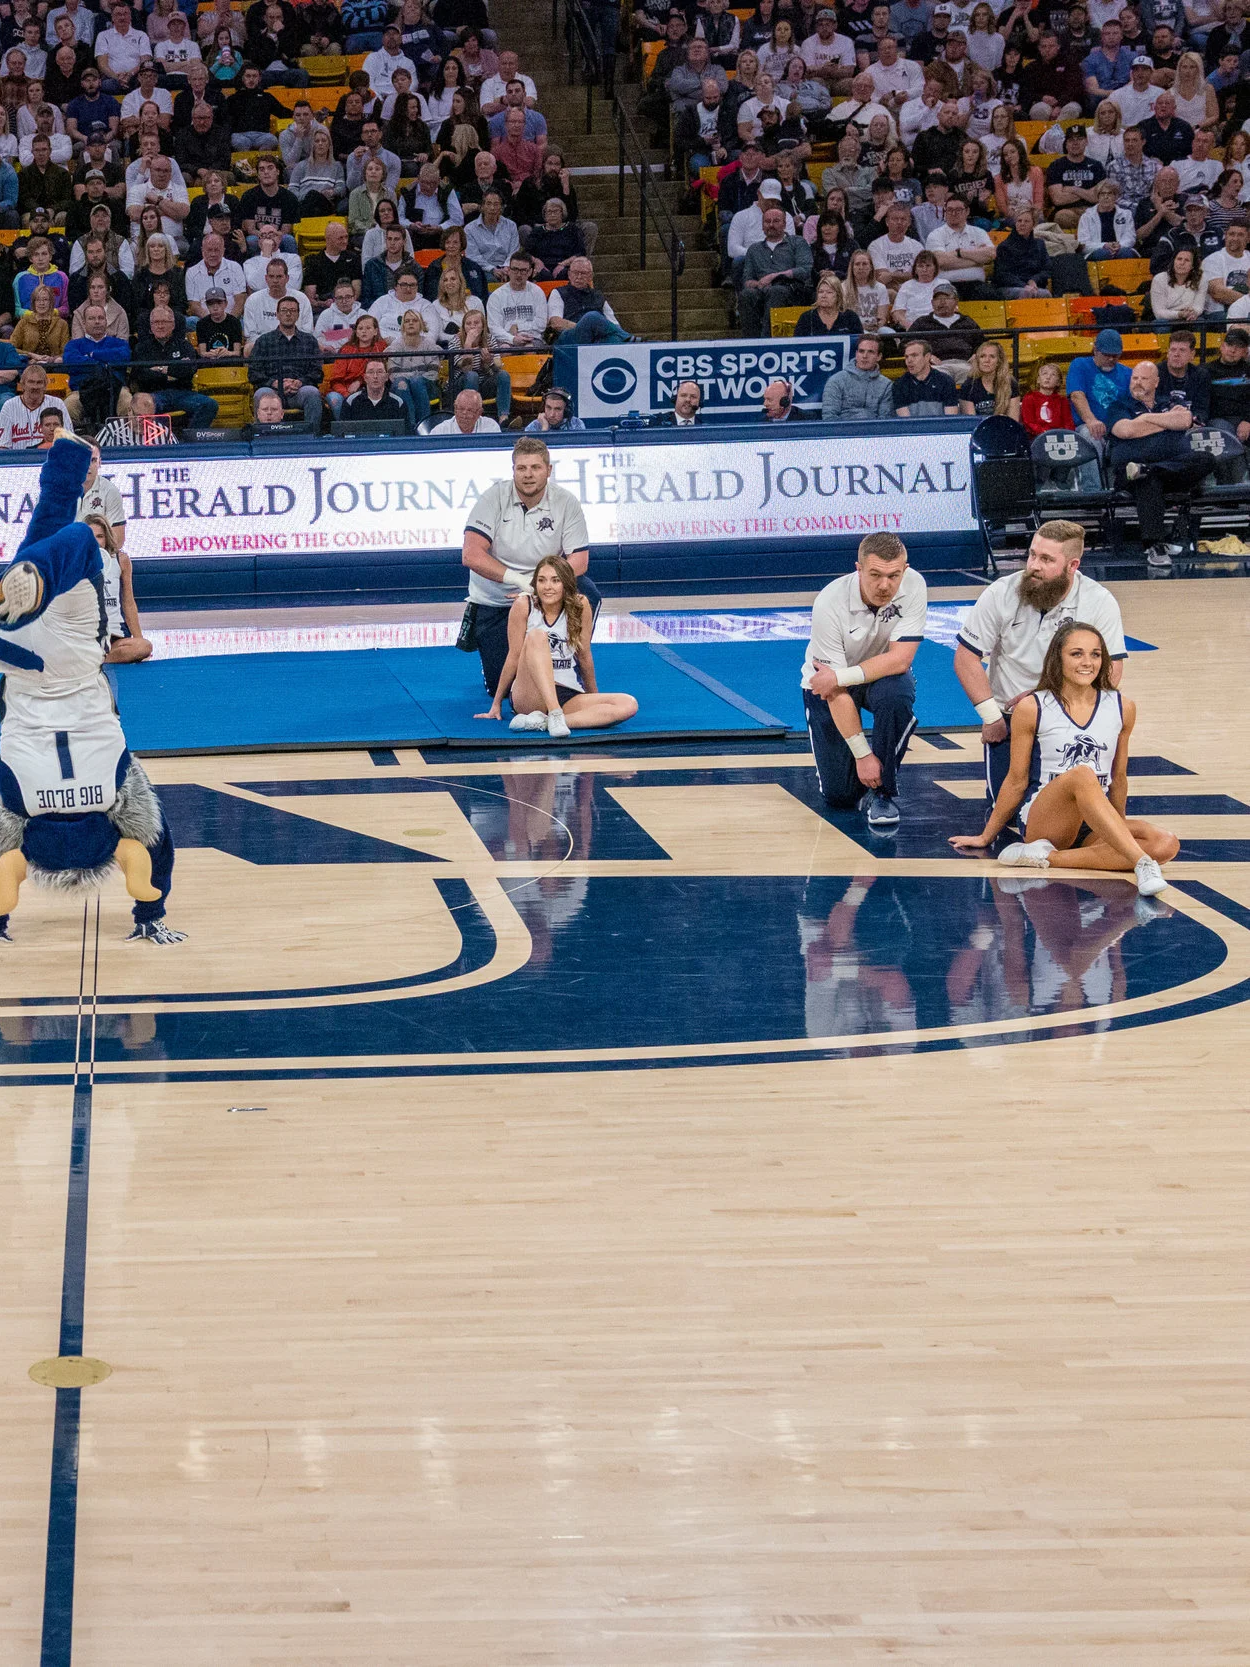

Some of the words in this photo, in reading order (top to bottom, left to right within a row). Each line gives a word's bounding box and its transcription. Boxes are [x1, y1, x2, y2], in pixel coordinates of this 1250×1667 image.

[254, 214, 282, 225] STATE
[655, 353, 714, 379] CBS
[720, 349, 837, 376] SPORTS
[656, 374, 809, 402] NTWOK
[598, 453, 636, 468] THE
[152, 467, 191, 483] THE
[551, 459, 744, 505] HERALD
[756, 451, 967, 509] JOURNAL
[308, 466, 503, 525] JOURNA
[609, 519, 736, 538] EMPOWERING
[741, 517, 778, 533] THE
[783, 513, 903, 533] COMMUNITY
[161, 533, 288, 553] EMPOWERING
[291, 531, 329, 549] THE
[333, 528, 452, 547] COMMUNITY
[36, 788, 75, 809] BLUE
[80, 784, 104, 806] BIG
